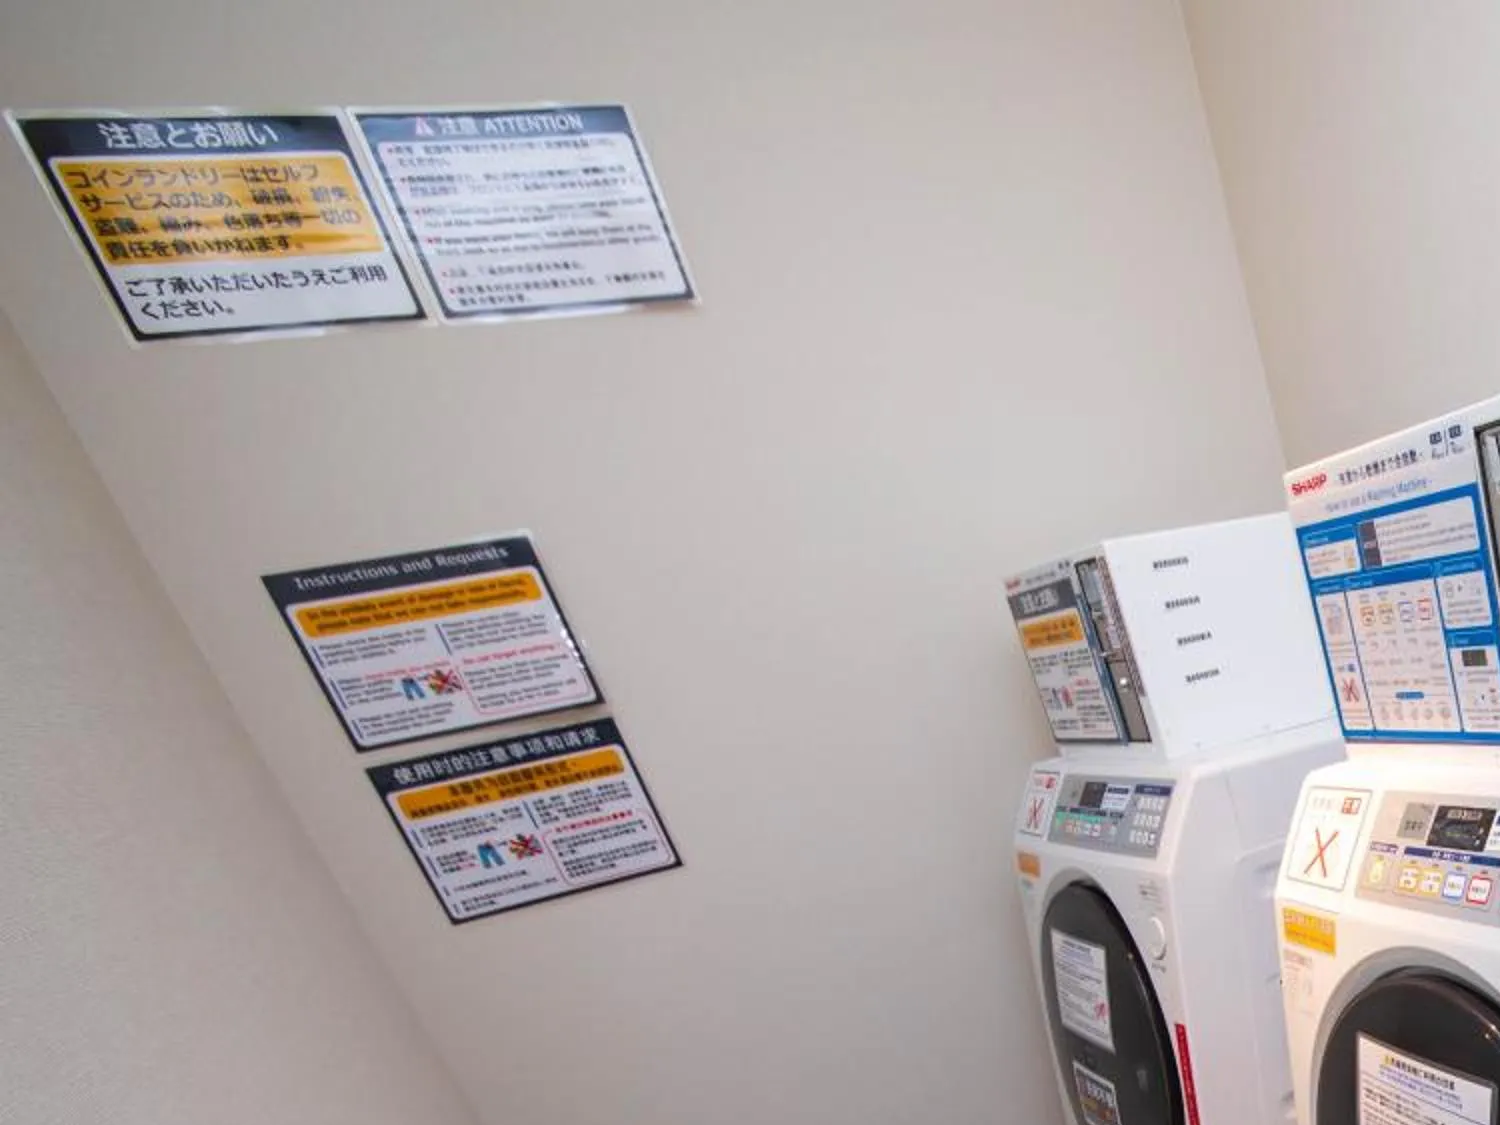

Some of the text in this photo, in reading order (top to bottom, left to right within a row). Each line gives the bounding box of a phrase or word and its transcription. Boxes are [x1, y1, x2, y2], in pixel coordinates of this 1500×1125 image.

[99, 121, 278, 150] 注意とお願い
[484, 112, 584, 134] ATTENTION
[64, 164, 320, 190] コインランドリーはセルフ
[107, 235, 305, 260] 責任を負いかねます。
[124, 265, 389, 298] ご了承いただいたうえご利用
[141, 300, 236, 320] ください。
[1291, 473, 1327, 496] SHARP
[293, 546, 510, 590] Instructions and Requests
